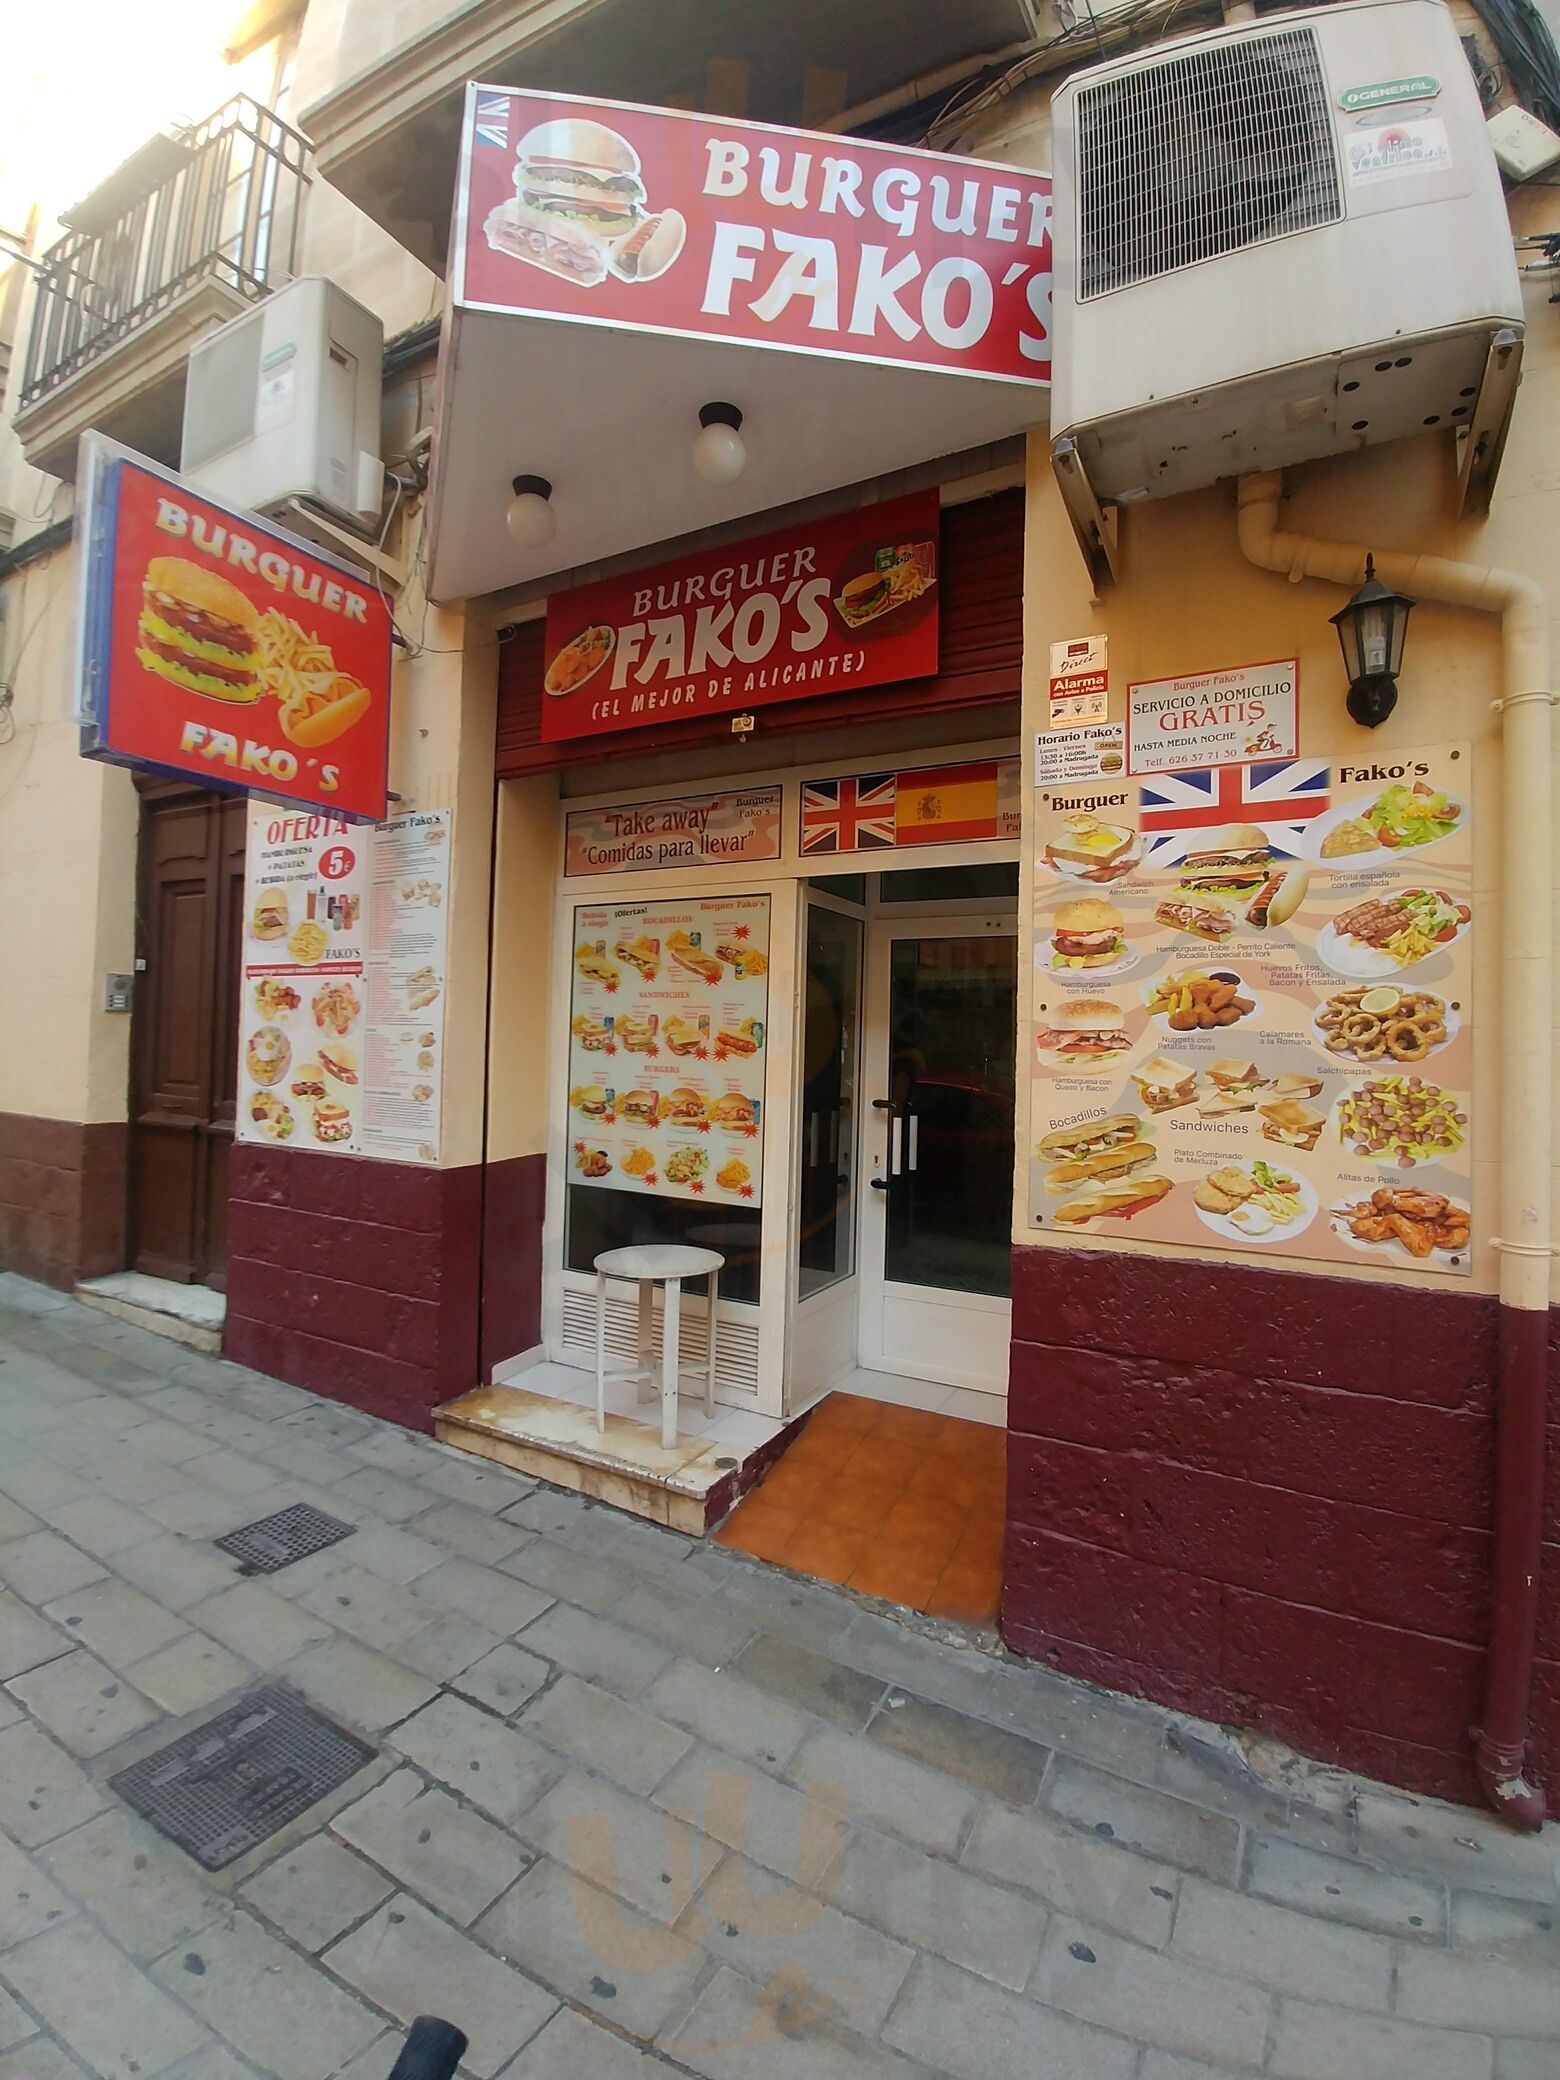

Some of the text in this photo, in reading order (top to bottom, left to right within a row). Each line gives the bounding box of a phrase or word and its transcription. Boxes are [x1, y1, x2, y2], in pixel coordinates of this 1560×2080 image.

[702, 138, 1051, 250] BURGUER
[155, 498, 368, 624] BURGUER
[632, 546, 817, 617] BURGUER
[609, 578, 832, 691] FAKO'S
[592, 650, 866, 721] (EL MEJOR DE ALICANTE)
[1053, 676, 1105, 691] Alarma
[1173, 673, 1245, 692] Burguer Fako's
[1133, 681, 1291, 715] SERVICIO A DOMICILIO
[1158, 700, 1266, 732] GRATIS
[1038, 727, 1122, 746] Horario Fako's
[1134, 732, 1236, 752] HASTA MEDIA NOCHE
[1064, 754, 1098, 763] Madrugada
[1169, 753, 1188, 764] 626
[1191, 752, 1204, 763] 37
[1208, 751, 1219, 761] 71
[1223, 749, 1237, 759] 30
[1064, 770, 1098, 778] Madrugada
[1339, 761, 1430, 783] Fako's
[736, 794, 775, 808] Burguer
[1052, 793, 1128, 813] Burguer
[739, 807, 771, 819] Fako's
[410, 814, 441, 828] Fako's
[659, 839, 694, 864] para
[1329, 871, 1400, 882] Tortilla española
[1117, 881, 1154, 889] Sandwich
[1350, 879, 1390, 889] ensalada
[1109, 888, 1149, 896] Americano
[643, 915, 693, 925] BOCADILLOS
[1156, 942, 1296, 953] Hamburguesa Doble Perrito Caliente
[325, 948, 361, 959] FAKO'S
[1176, 951, 1208, 960] Bocadillo
[1210, 951, 1241, 960] Especial
[1254, 950, 1271, 958] York
[1261, 964, 1292, 972] Huevos
[1271, 971, 1303, 979] Patatas
[1061, 981, 1111, 989] Hamburguesa
[1306, 978, 1346, 986] Ensalada
[639, 991, 690, 999] SANDWICHES
[1081, 987, 1105, 995] Huevo
[1259, 1030, 1305, 1039] Calamares
[1161, 1036, 1194, 1046] Nuggets
[1276, 1038, 1312, 1046] Romana
[1157, 1043, 1188, 1051] Patatas
[644, 1065, 680, 1073] BURGERS
[1317, 1066, 1372, 1077] Salchipapas
[1052, 1077, 1098, 1087] Hamburguesa
[1049, 1106, 1107, 1130] Bocadillos
[1170, 1120, 1249, 1134] Sandwiches
[1174, 1149, 1243, 1160] Plato Combinado
[1186, 1157, 1218, 1166] Merluza
[1337, 1173, 1400, 1185] Alitas de Pollo
